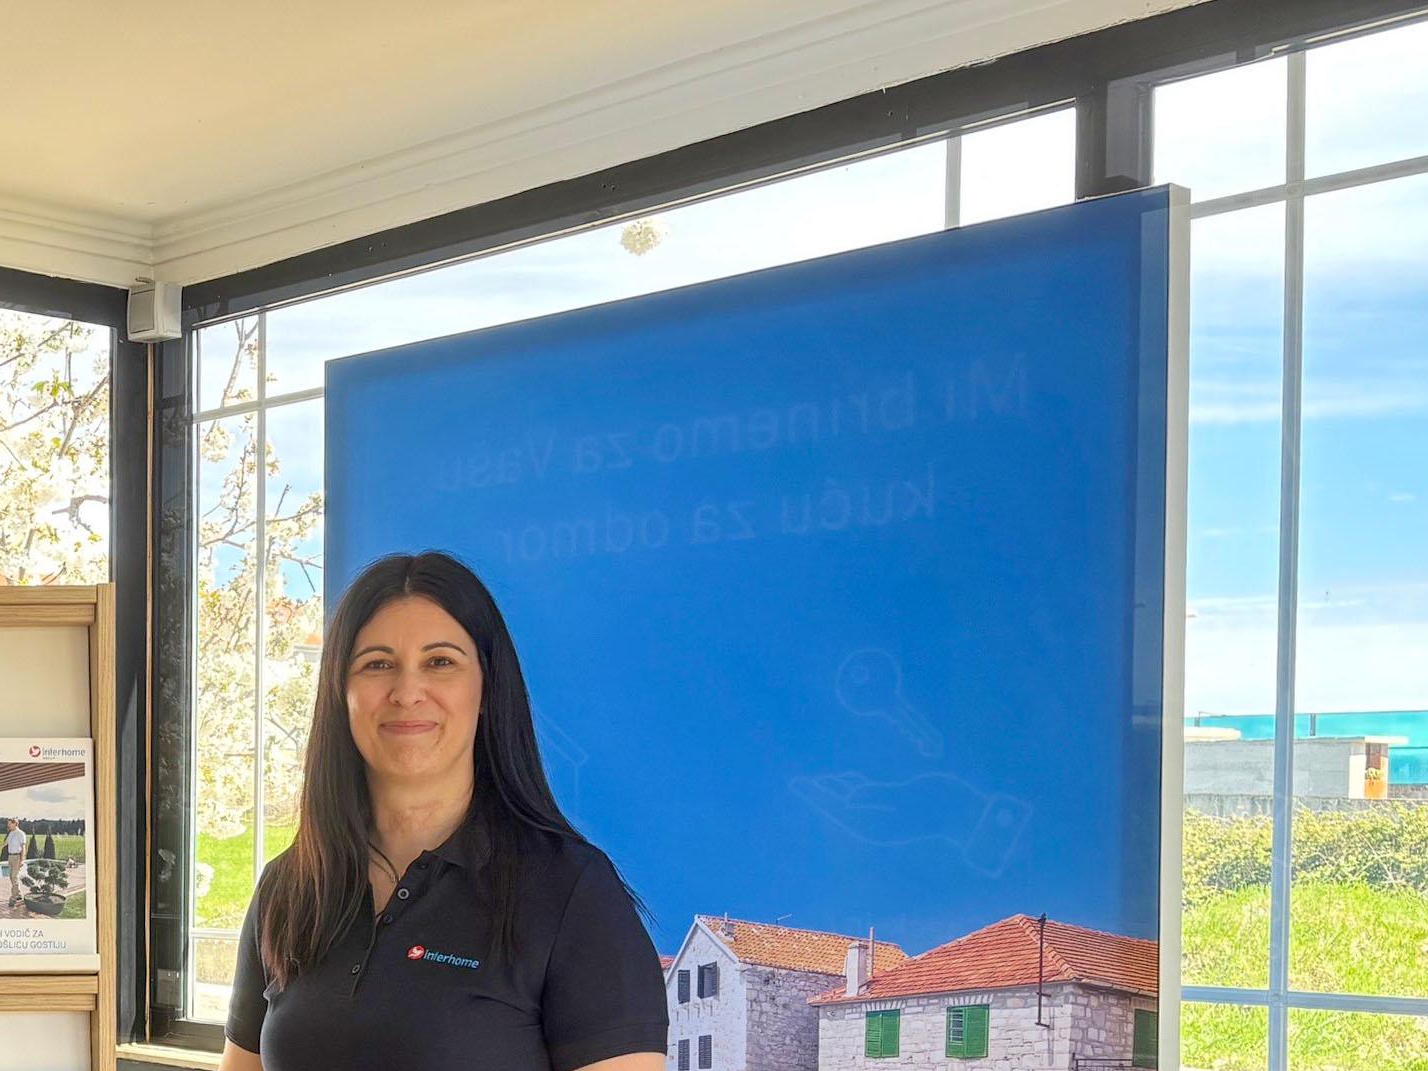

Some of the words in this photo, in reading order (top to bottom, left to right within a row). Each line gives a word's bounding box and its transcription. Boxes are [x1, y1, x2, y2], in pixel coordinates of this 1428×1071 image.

[42, 746, 85, 757] interhome
[32, 929, 44, 938] ZA
[30, 940, 67, 949] GOSTIJU
[423, 949, 480, 969] interhome
